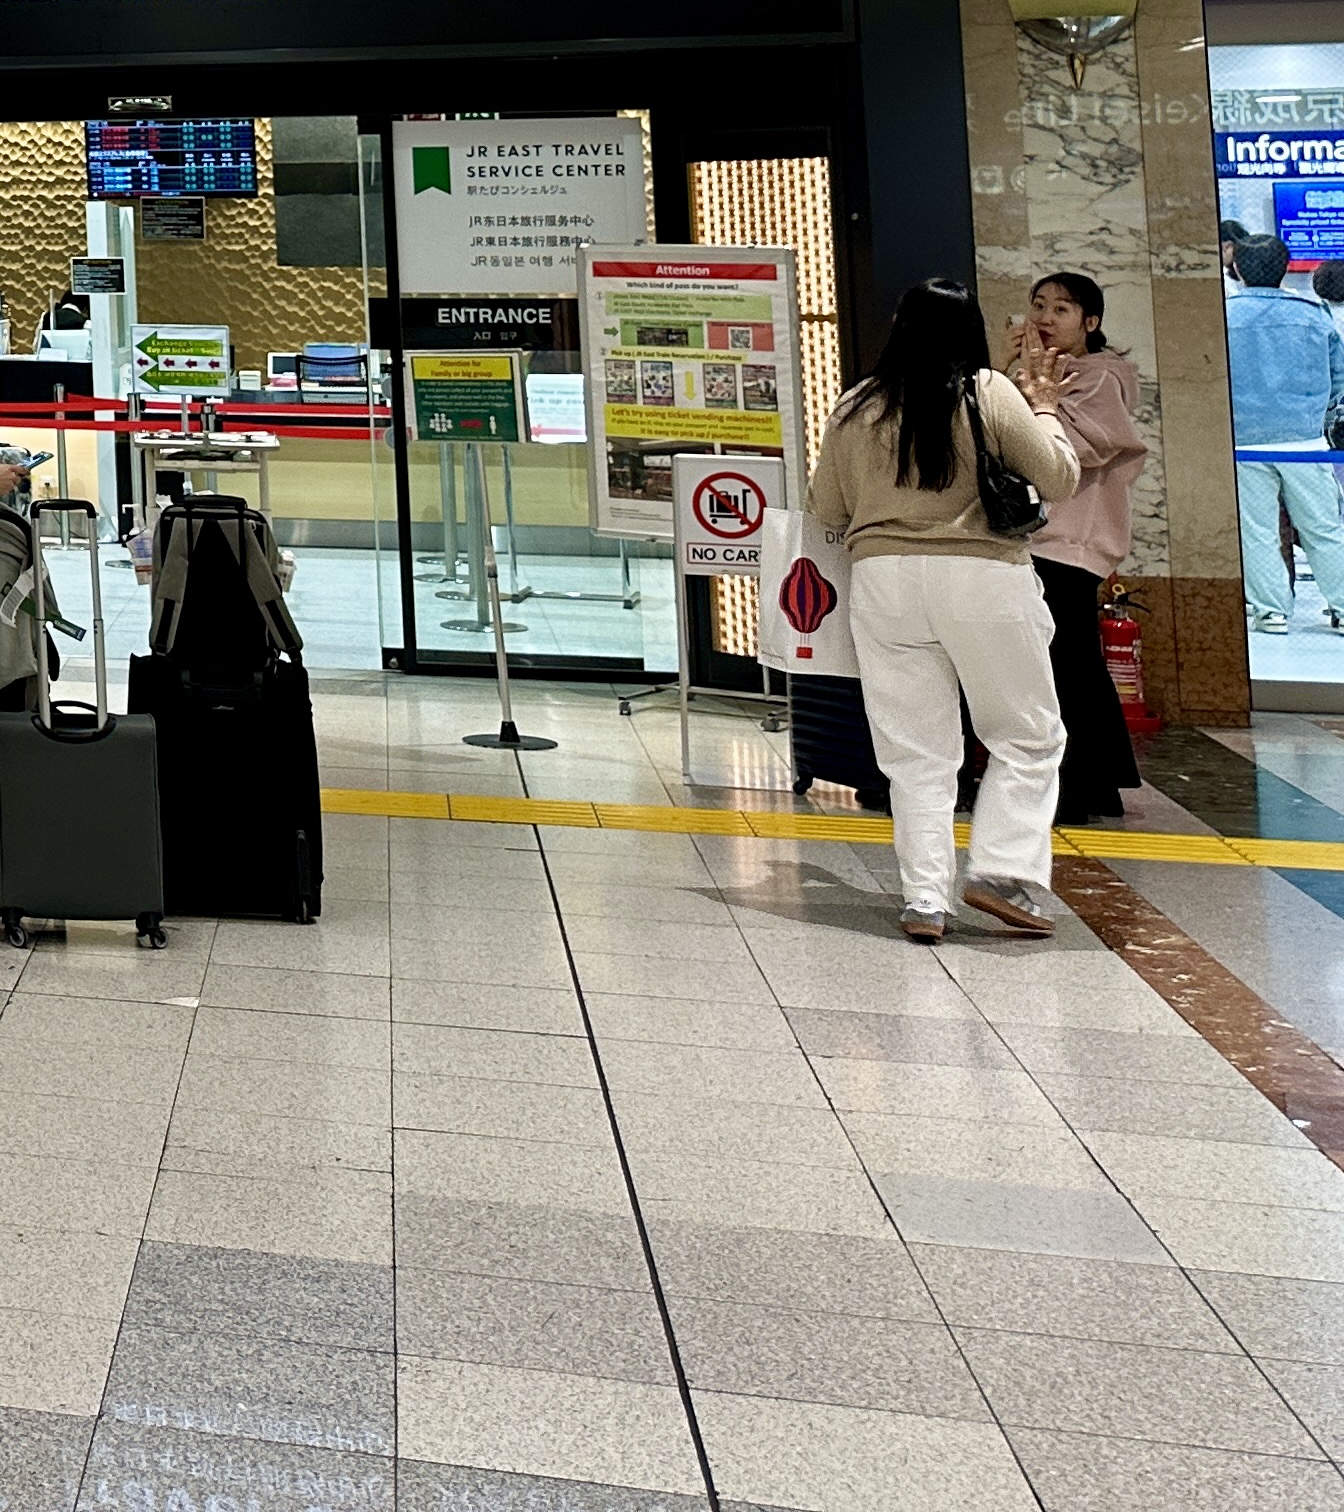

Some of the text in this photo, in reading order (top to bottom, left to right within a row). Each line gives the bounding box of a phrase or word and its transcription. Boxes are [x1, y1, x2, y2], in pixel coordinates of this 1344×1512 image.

[466, 144, 623, 157] JR EAST TRAVEL
[467, 165, 625, 178] SERVICE CENTER
[656, 265, 709, 275] Attention
[438, 308, 551, 323] ENTRANCE
[692, 547, 761, 562] NO CAR
